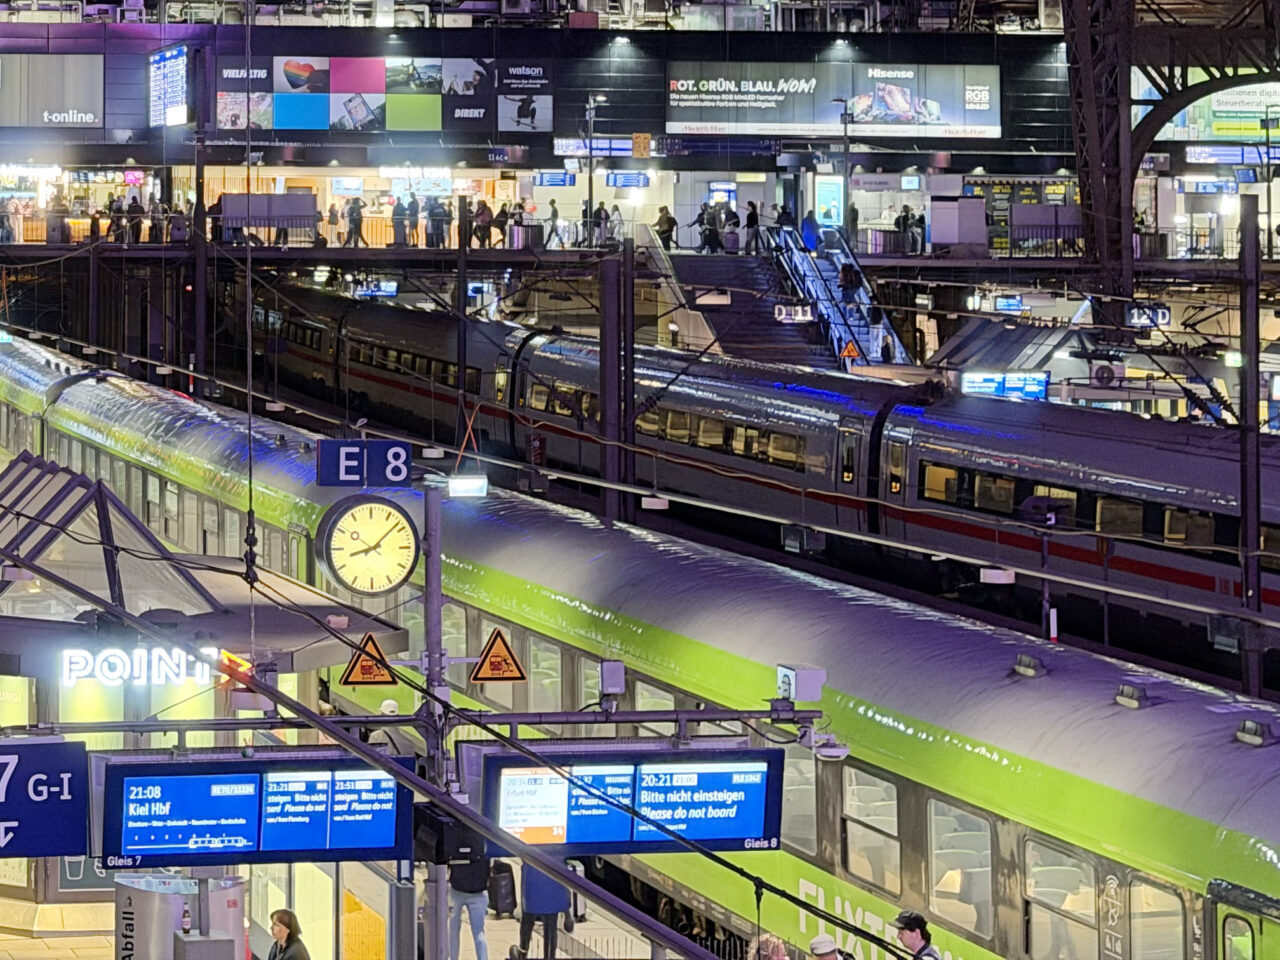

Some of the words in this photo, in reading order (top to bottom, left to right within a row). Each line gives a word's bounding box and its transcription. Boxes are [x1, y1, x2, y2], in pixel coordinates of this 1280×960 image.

[509, 66, 543, 76] watson
[868, 68, 914, 79] Hisense
[670, 80, 697, 91] ROT.
[699, 77, 738, 91] GRÜN.
[741, 80, 775, 91] BLAU.
[776, 77, 817, 93] WOW!
[965, 90, 990, 101] RGB
[43, 109, 98, 124] t-online.
[454, 108, 485, 119] DIREKT
[775, 305, 786, 321] D
[795, 305, 813, 321] 11
[1131, 308, 1151, 324] 12
[1157, 308, 1170, 324] D
[339, 446, 360, 481] E
[385, 446, 408, 482] 8
[62, 646, 219, 686] POINT
[27, 772, 73, 802] G-I
[641, 774, 671, 787] 20:21
[129, 786, 161, 800] 21:08
[294, 793, 311, 802] Bitte
[311, 793, 327, 802] nicht
[361, 792, 377, 801] Bitte
[377, 791, 393, 800] nicht
[641, 791, 665, 803] Bitte
[667, 790, 692, 803] nicht
[693, 790, 745, 805] einsteigen
[129, 803, 149, 816] Kiel
[151, 802, 171, 816] Hbf
[306, 804, 314, 812] do
[372, 802, 381, 810] do
[640, 807, 672, 820] Please
[674, 806, 687, 819] do
[688, 806, 706, 818] not
[707, 805, 738, 818] board
[744, 839, 769, 849] Gleis
[770, 838, 778, 848] 8
[107, 855, 133, 867] Gleis
[135, 855, 142, 866] 7
[121, 911, 135, 960] Abfall
